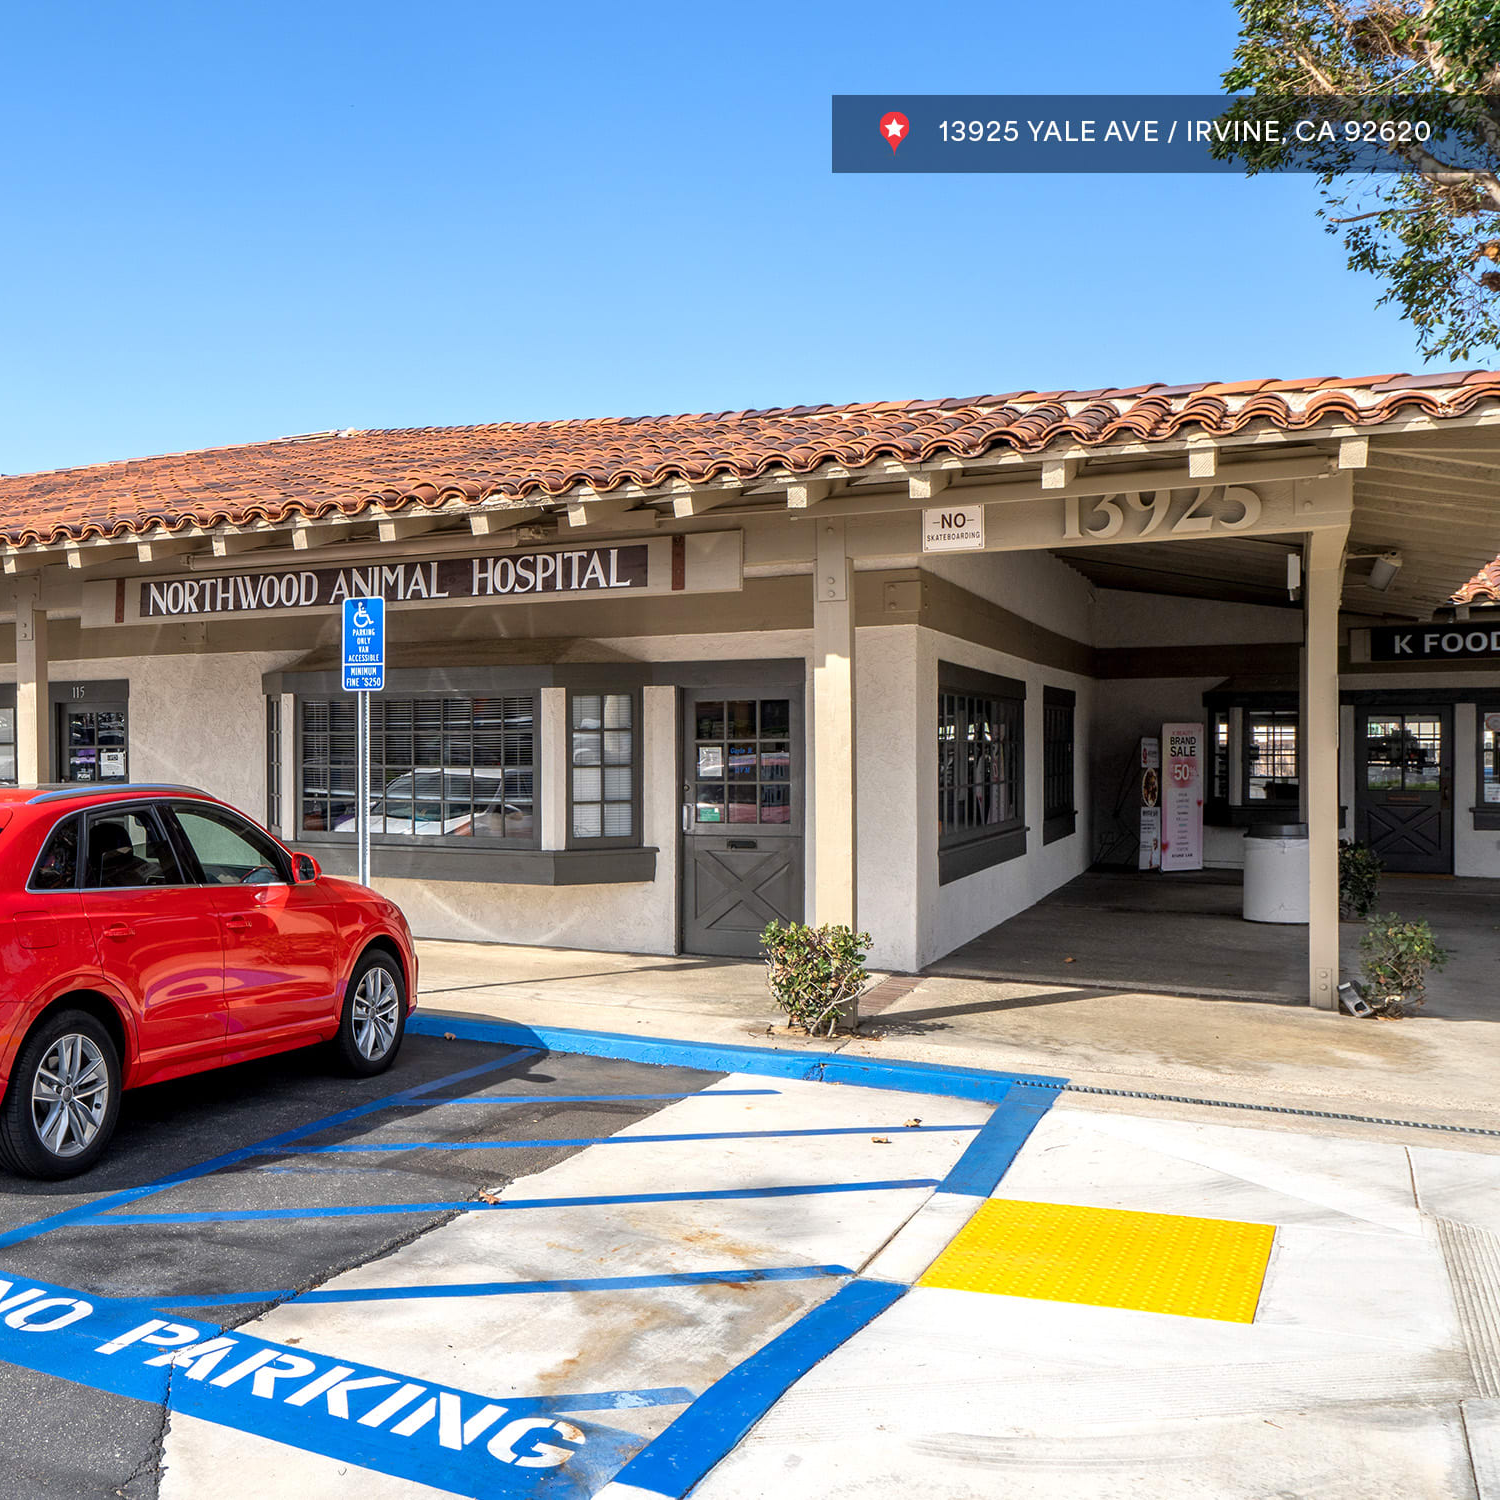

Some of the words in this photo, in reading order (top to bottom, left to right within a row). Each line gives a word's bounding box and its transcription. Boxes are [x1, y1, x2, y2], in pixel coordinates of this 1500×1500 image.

[941, 512, 967, 529] NO
[926, 530, 981, 542] SKATEBOARDING
[148, 571, 318, 617] NORTHWOOD
[329, 561, 450, 605] ANIMAL
[471, 548, 631, 597] HOSPITAL
[352, 628, 376, 637] PARKING
[356, 637, 371, 645] ONLY
[1394, 634, 1413, 654] K
[348, 654, 380, 662] ACCESSIBLE
[350, 666, 377, 676] MINIMUM
[346, 677, 360, 687] FINE
[363, 677, 381, 687] $250
[72, 686, 85, 699] 115
[1170, 736, 1197, 745] BRAND
[1170, 745, 1197, 757] SALE
[94, 1317, 586, 1468] PARKING
